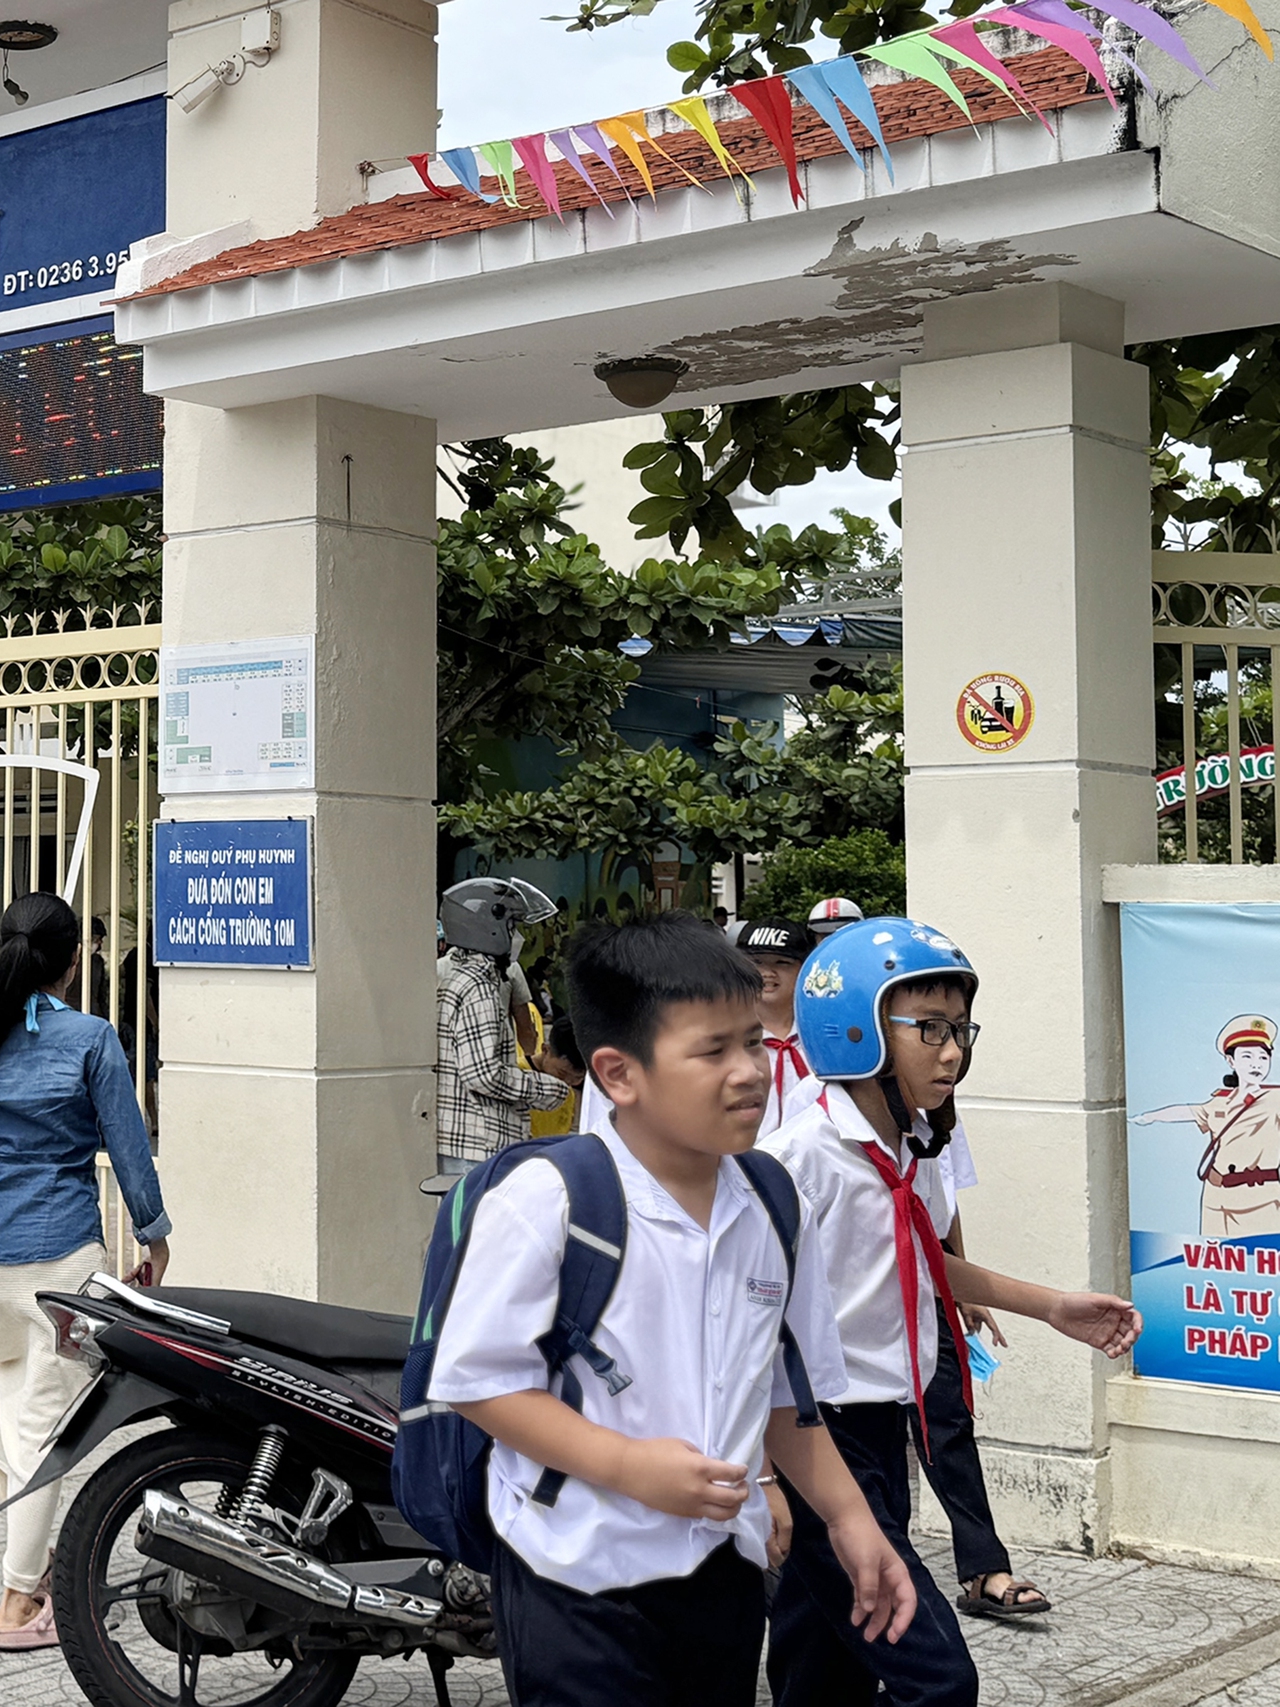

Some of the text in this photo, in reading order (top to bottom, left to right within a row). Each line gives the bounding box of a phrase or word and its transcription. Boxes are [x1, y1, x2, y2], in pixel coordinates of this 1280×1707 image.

[37, 259, 83, 288] 0236
[184, 850, 209, 868] NGHỊ
[235, 850, 256, 868] PHỤ
[188, 871, 274, 905] ĐƯA ĐÓN CON EM
[168, 905, 295, 946] CÁCH CỔNG TRƯỜNG 10M
[748, 927, 790, 946] NIKE
[1183, 1240, 1280, 1275] VĂN H
[1185, 1282, 1273, 1322] LÀ TỰ
[1187, 1327, 1270, 1359] PHÁP
[234, 1357, 354, 1405] SIRIUS
